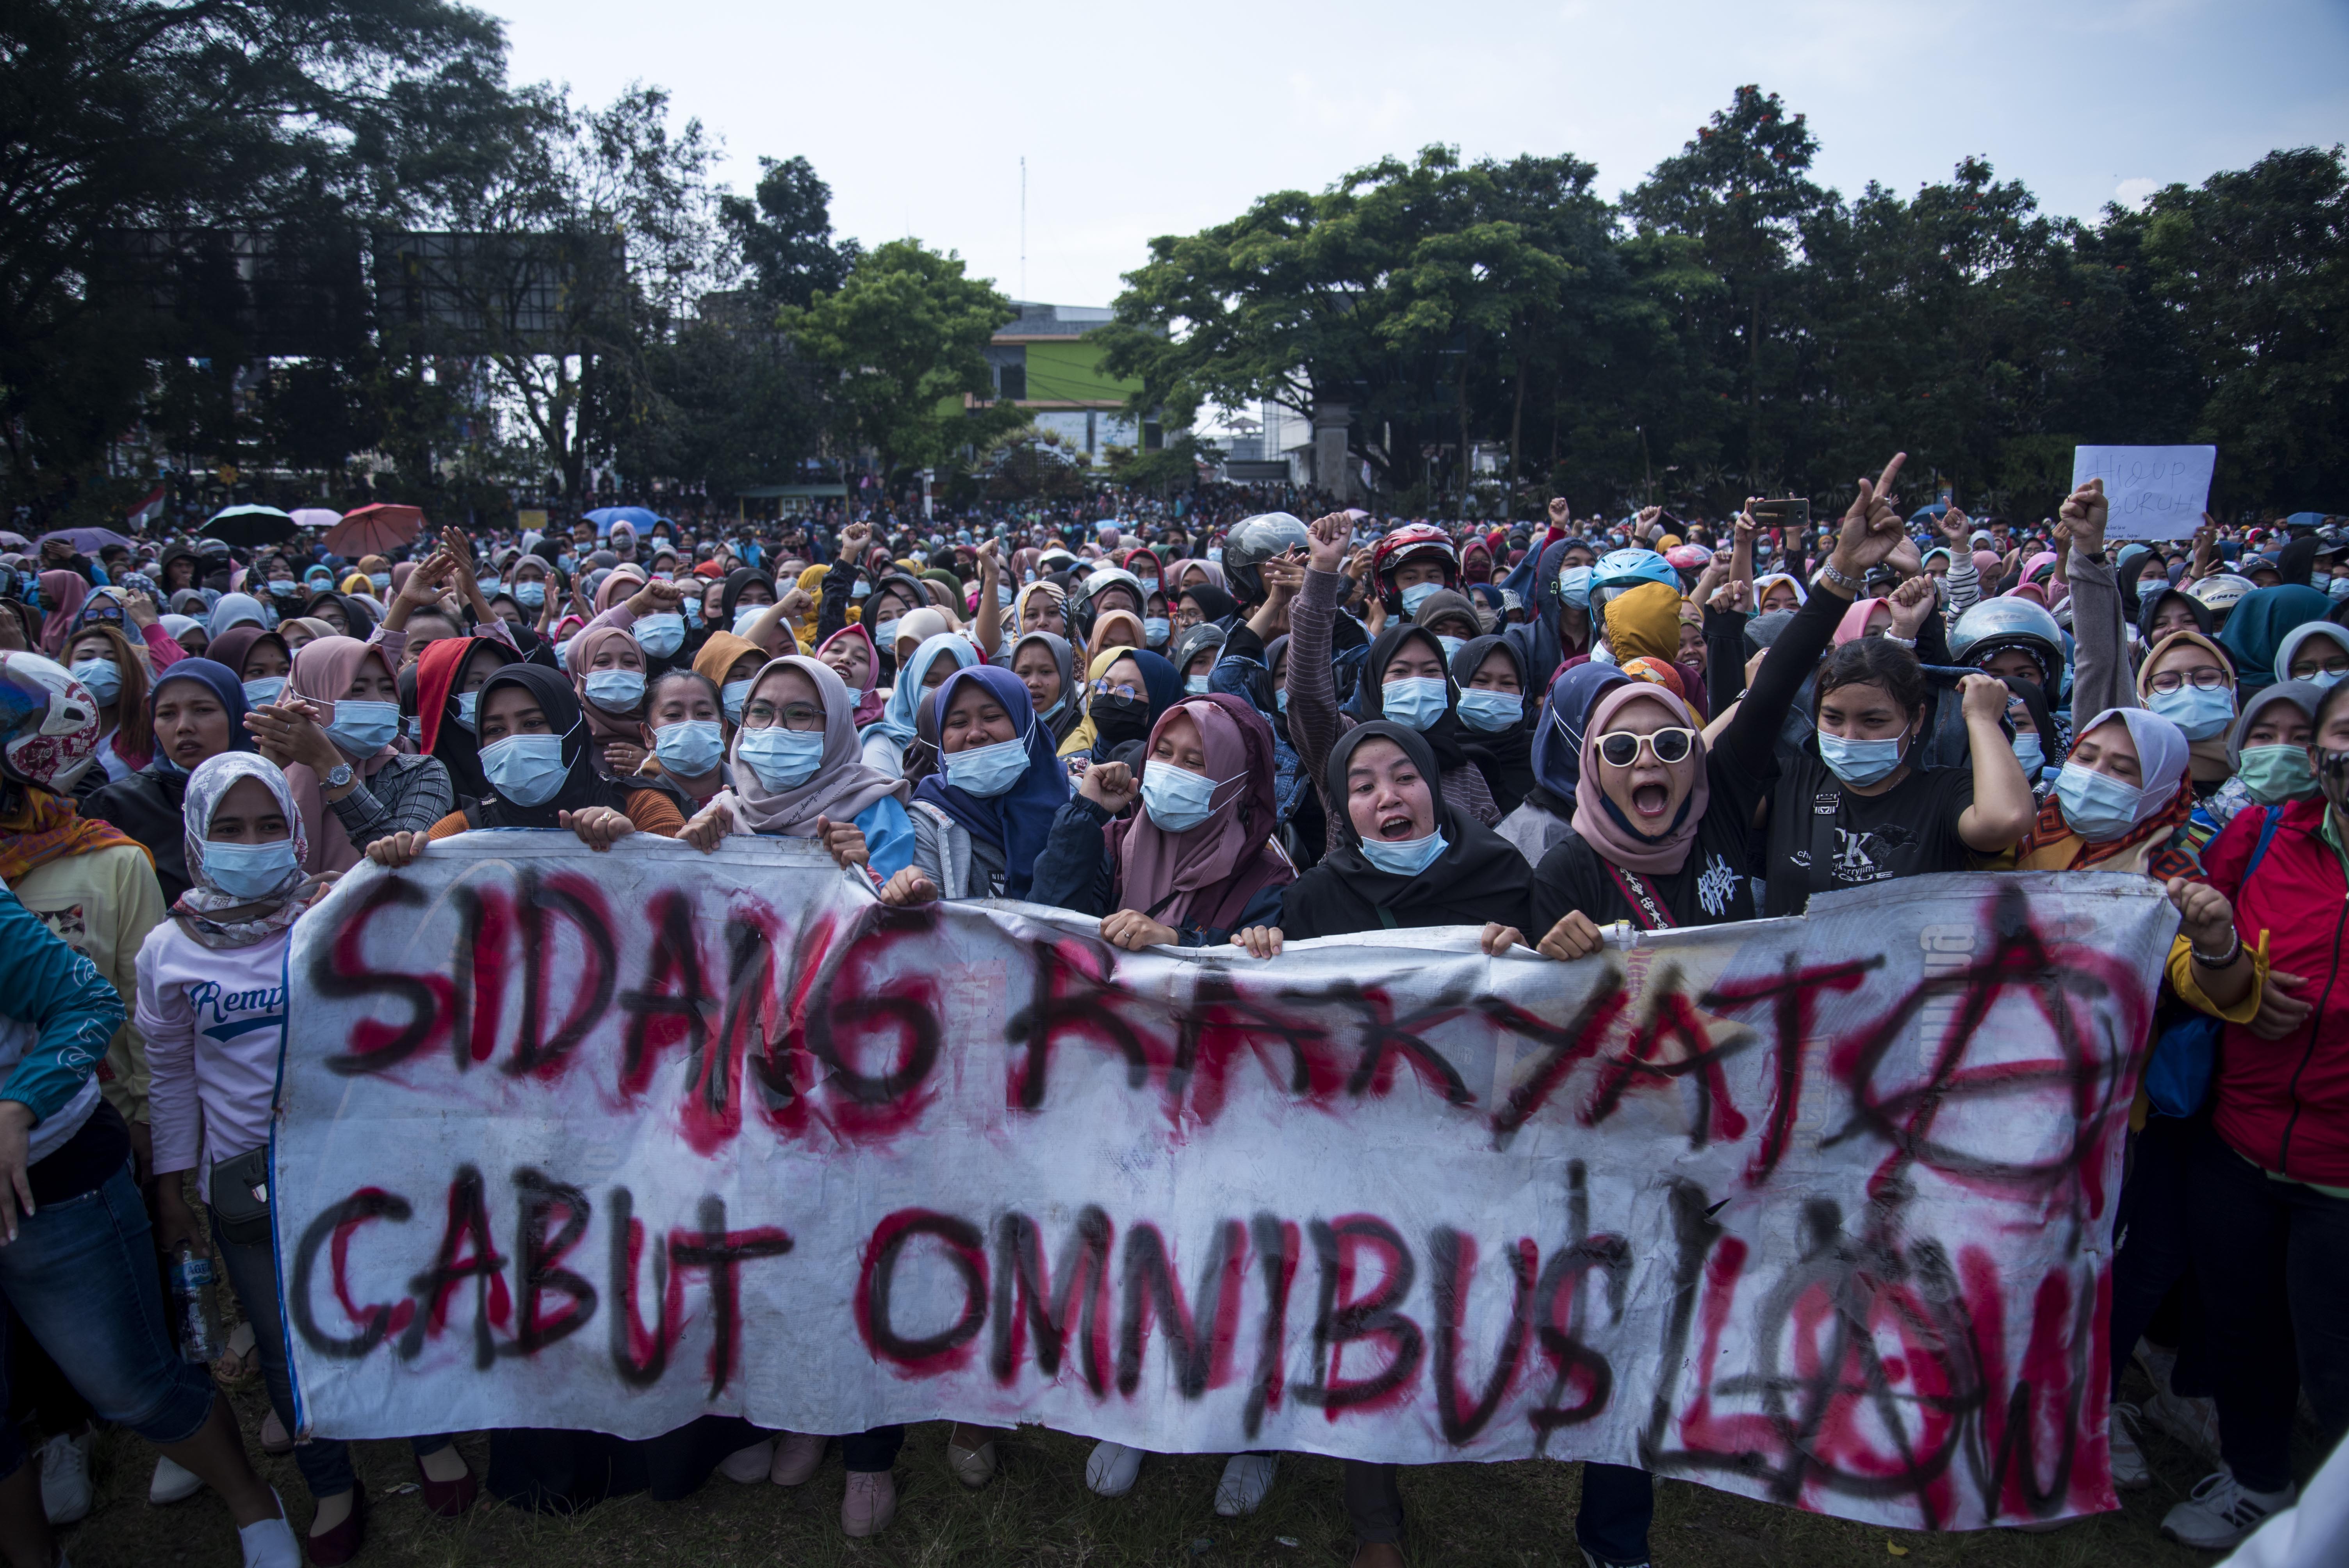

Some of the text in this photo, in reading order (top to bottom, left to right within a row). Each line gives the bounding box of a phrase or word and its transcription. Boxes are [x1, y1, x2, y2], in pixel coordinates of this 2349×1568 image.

[308, 869, 939, 1154] SIDANG
[1004, 937, 1886, 1185] RAKYAT
[291, 1164, 794, 1400] CABUT
